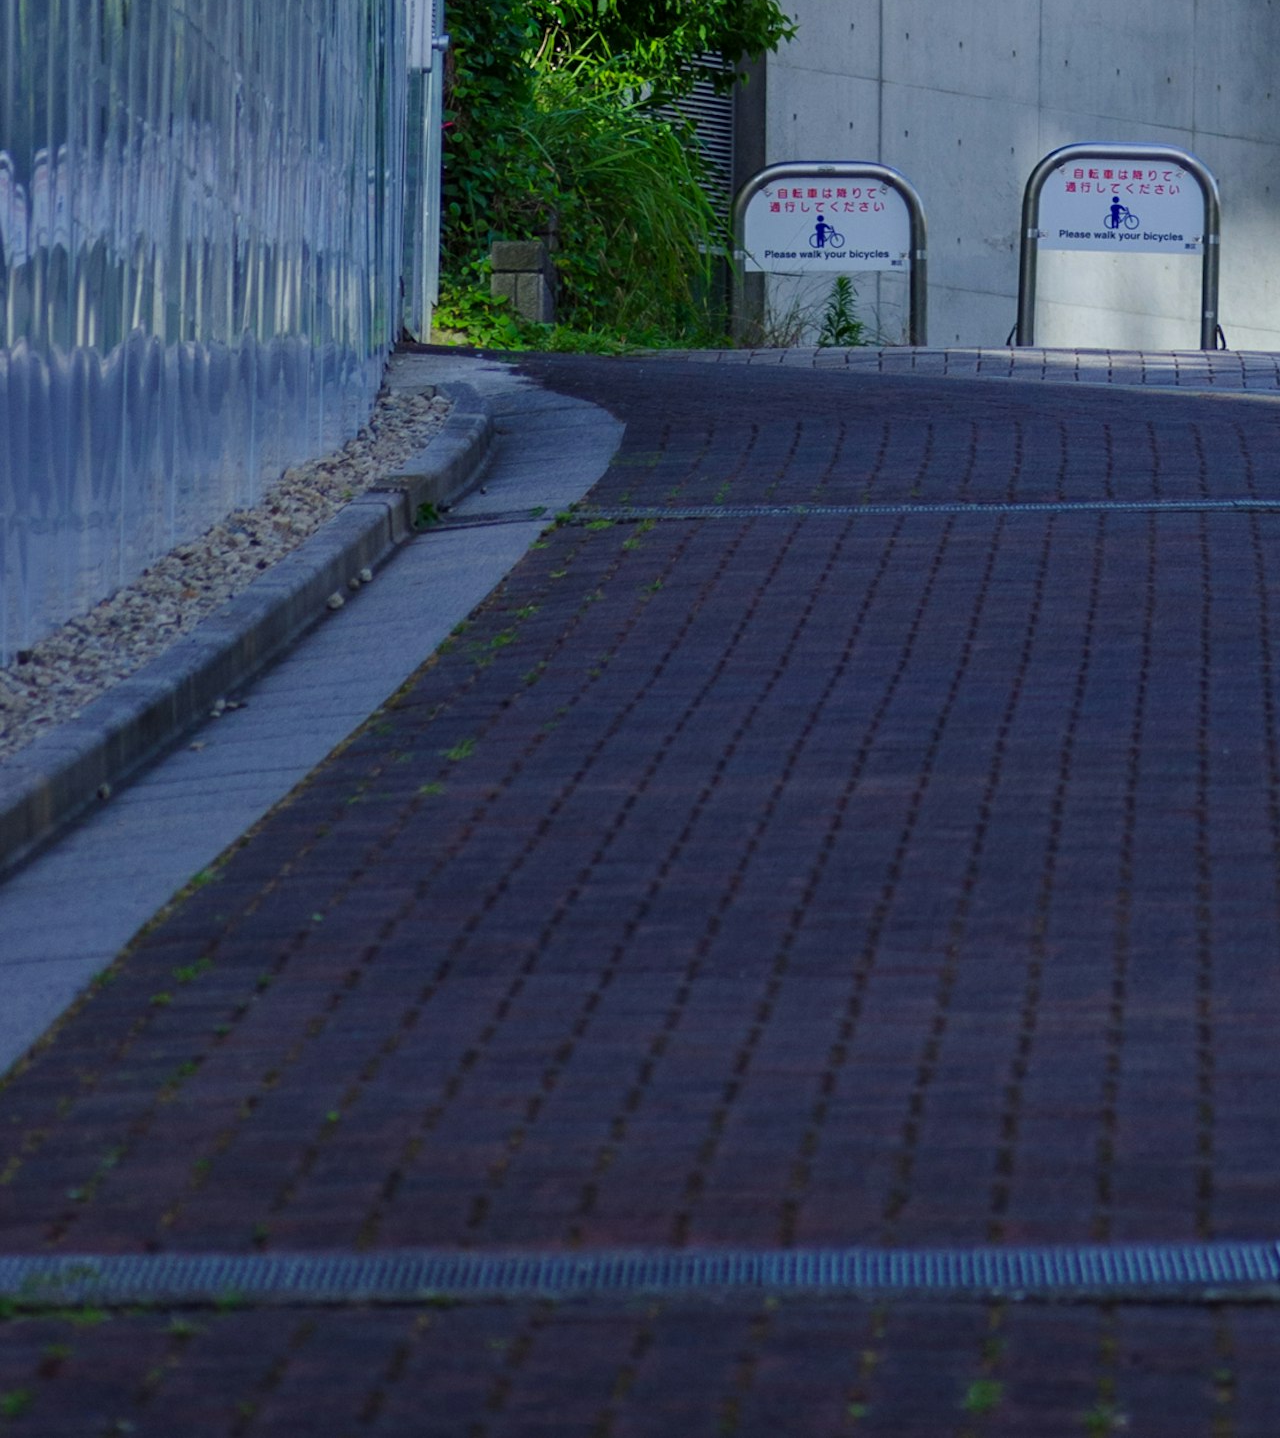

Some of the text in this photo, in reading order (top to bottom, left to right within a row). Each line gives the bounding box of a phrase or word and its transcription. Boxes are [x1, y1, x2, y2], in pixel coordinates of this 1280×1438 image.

[1073, 168, 1173, 182] 自転車は降りて
[778, 187, 877, 199] 自転車は降りて
[1065, 181, 1180, 195] 通行してください
[769, 201, 885, 213] 通行してください
[1059, 229, 1183, 242] Please walk your bicycles
[764, 250, 889, 260] Please walk your bicycles
